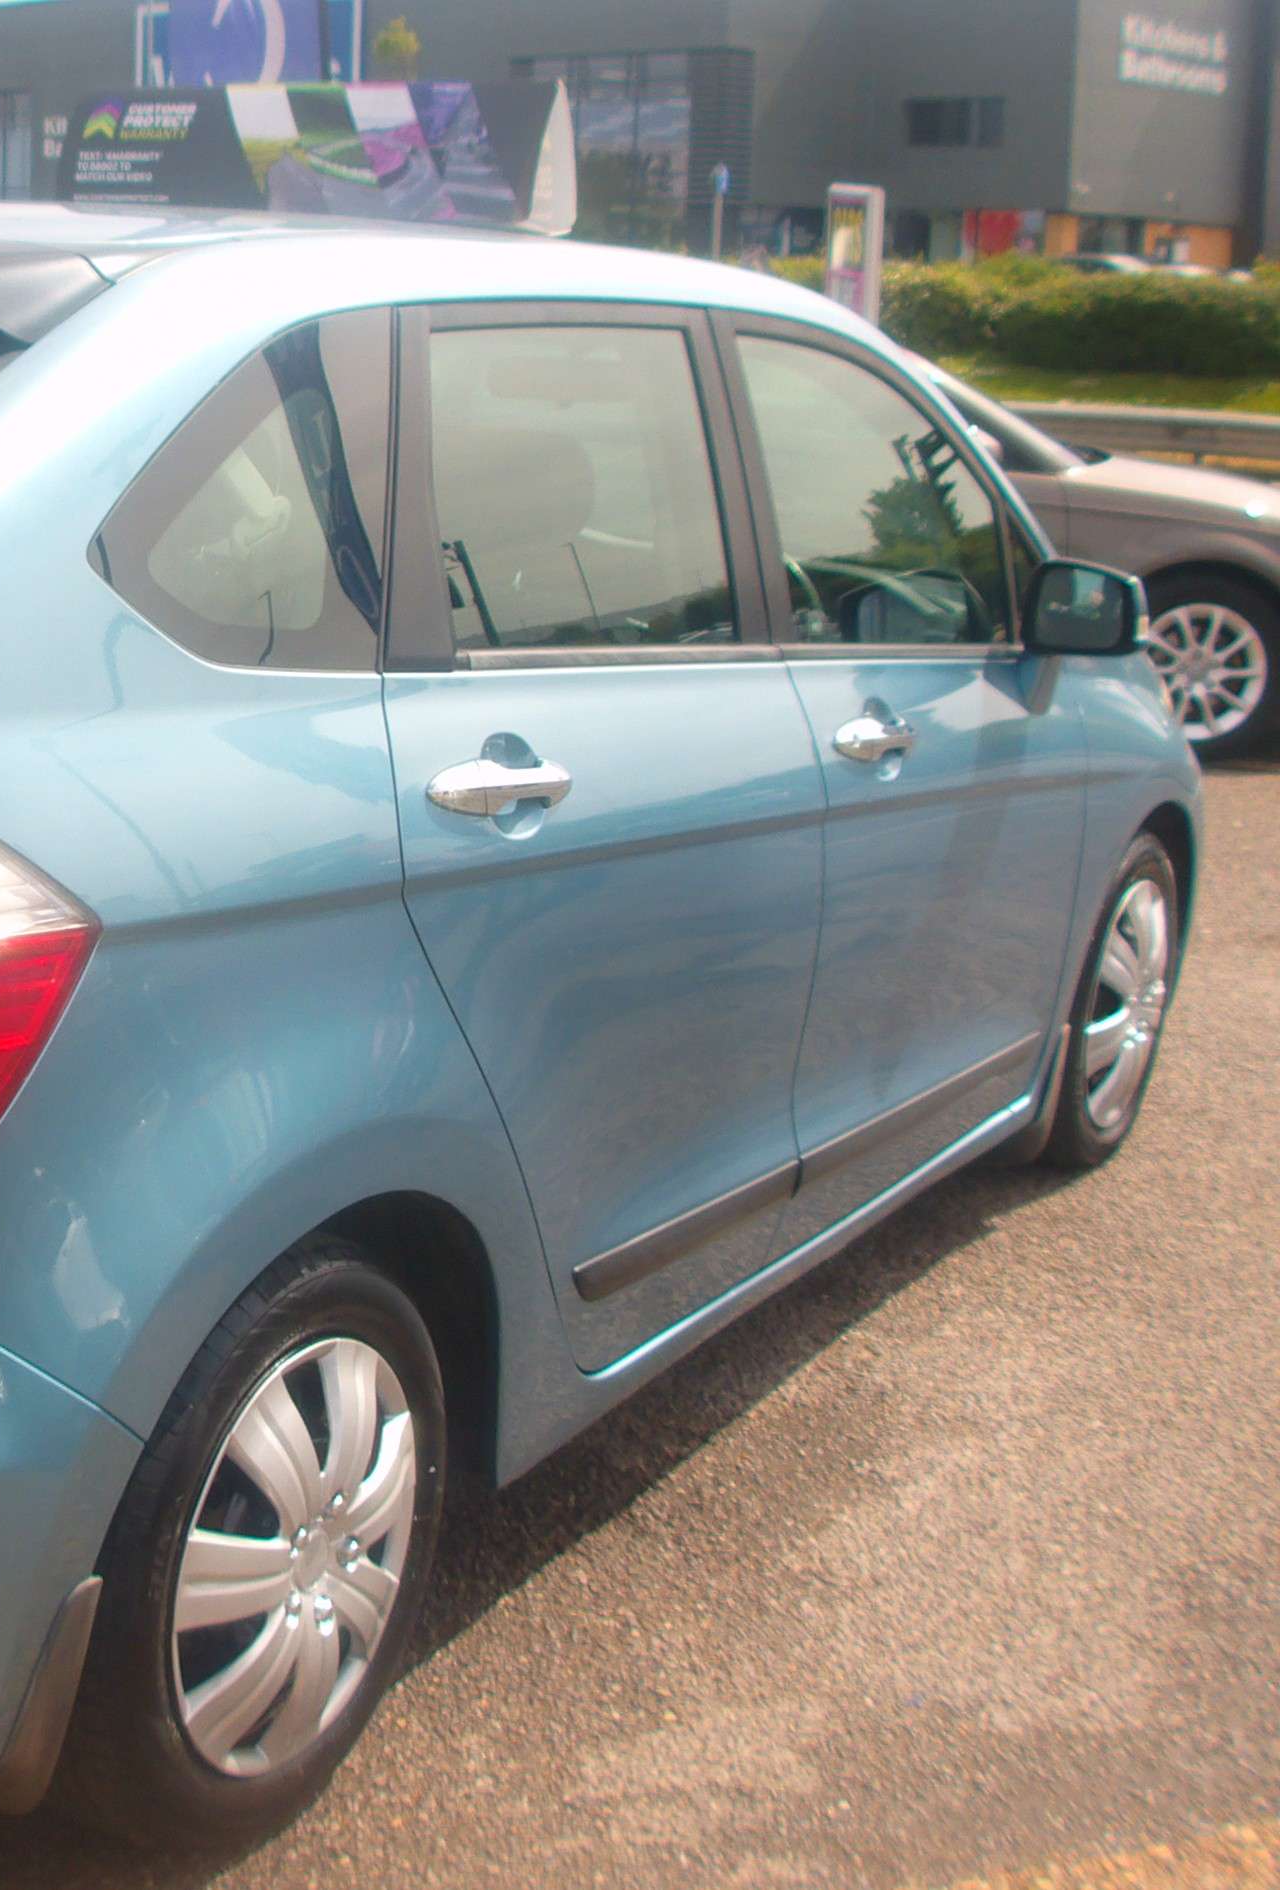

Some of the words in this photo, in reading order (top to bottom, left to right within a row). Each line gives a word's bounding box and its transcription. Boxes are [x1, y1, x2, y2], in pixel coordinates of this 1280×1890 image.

[128, 103, 197, 115] CUSTOMER
[123, 115, 193, 127] PROTECT
[120, 128, 188, 140] WARRANTY
[120, 162, 131, 171] TO
[106, 172, 125, 181] OUR
[126, 172, 152, 182] VIDEO
